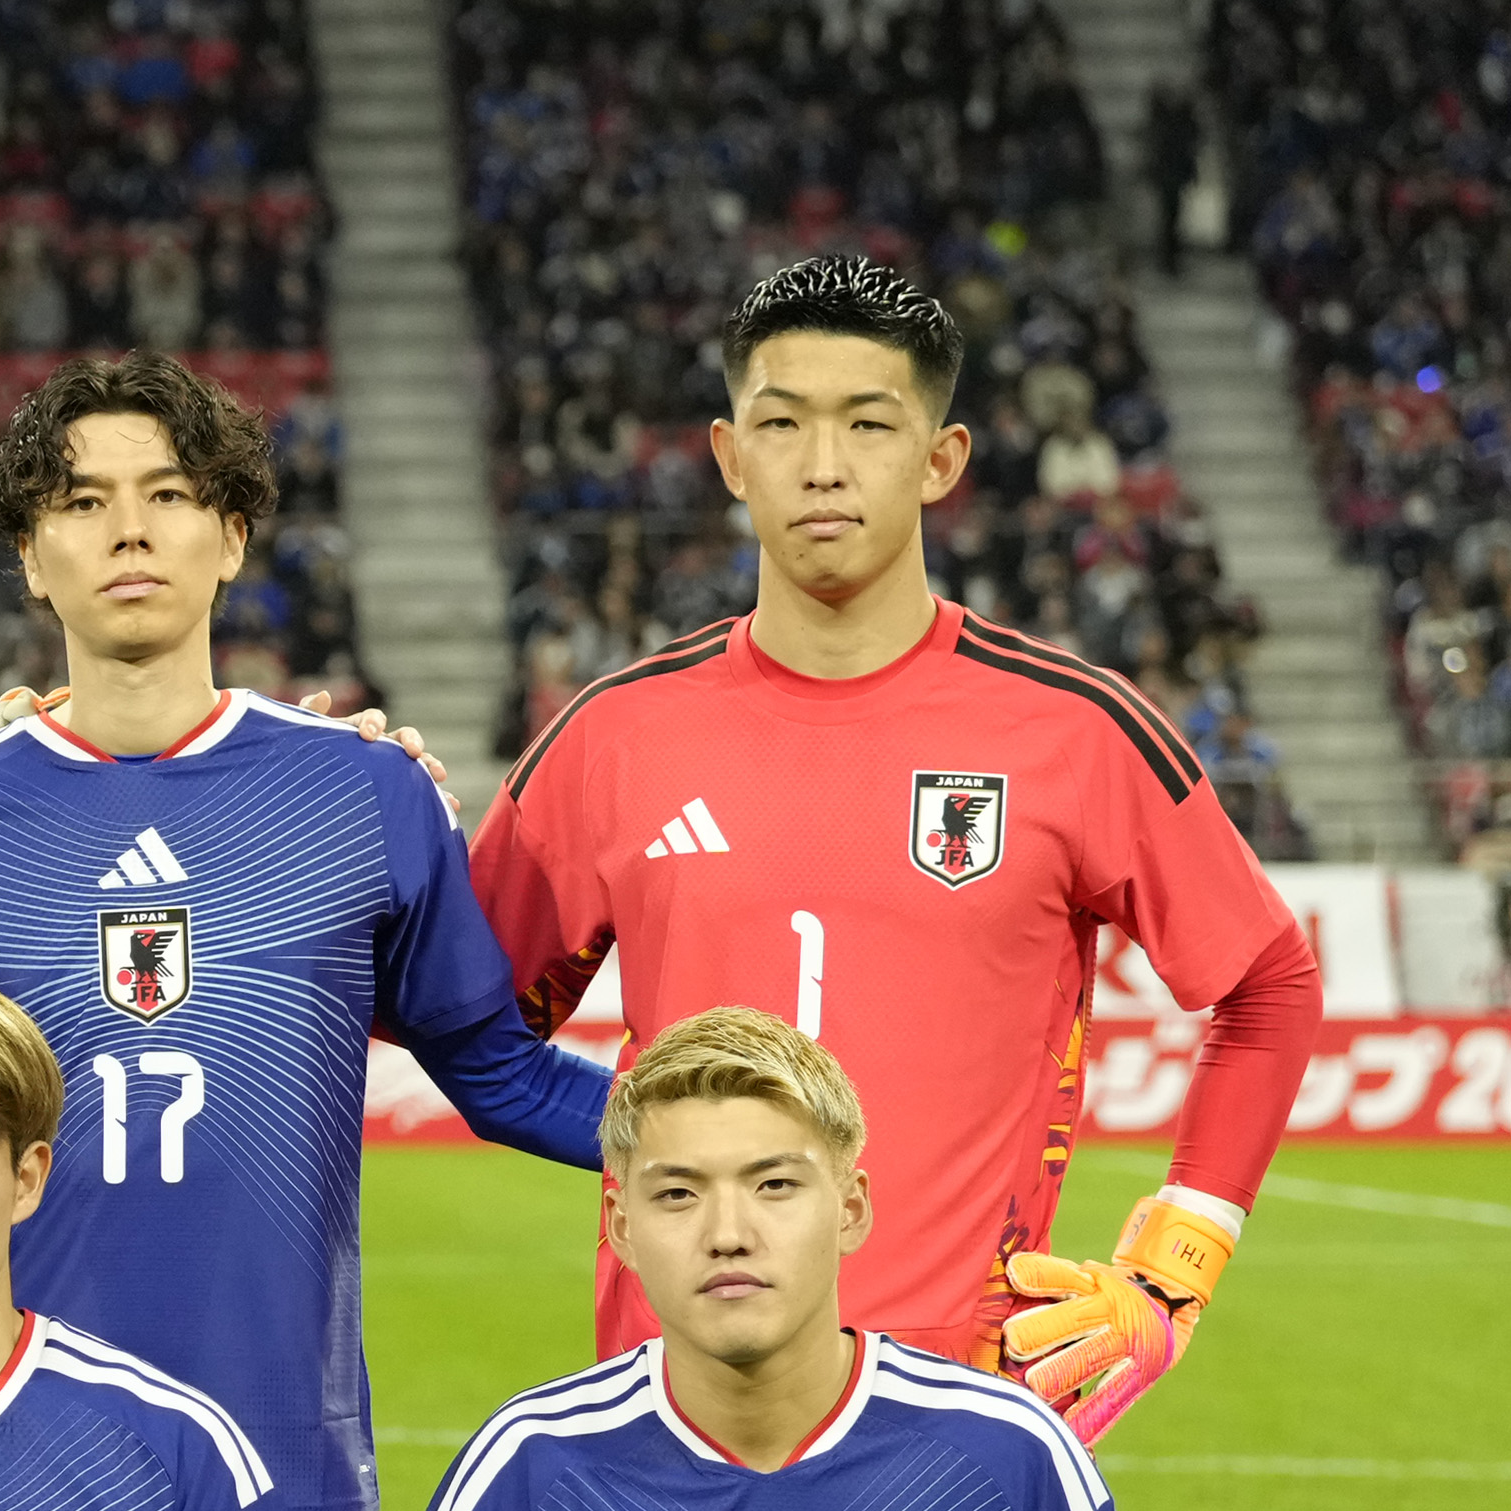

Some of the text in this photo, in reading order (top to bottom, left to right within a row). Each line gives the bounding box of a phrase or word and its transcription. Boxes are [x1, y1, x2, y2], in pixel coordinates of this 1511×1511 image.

[936, 776, 984, 788] JAPAN
[934, 849, 974, 867] JFA
[120, 912, 168, 923] JAPAN
[790, 911, 825, 1038] 1
[127, 985, 166, 1003] JFA
[93, 1051, 204, 1184] 17
